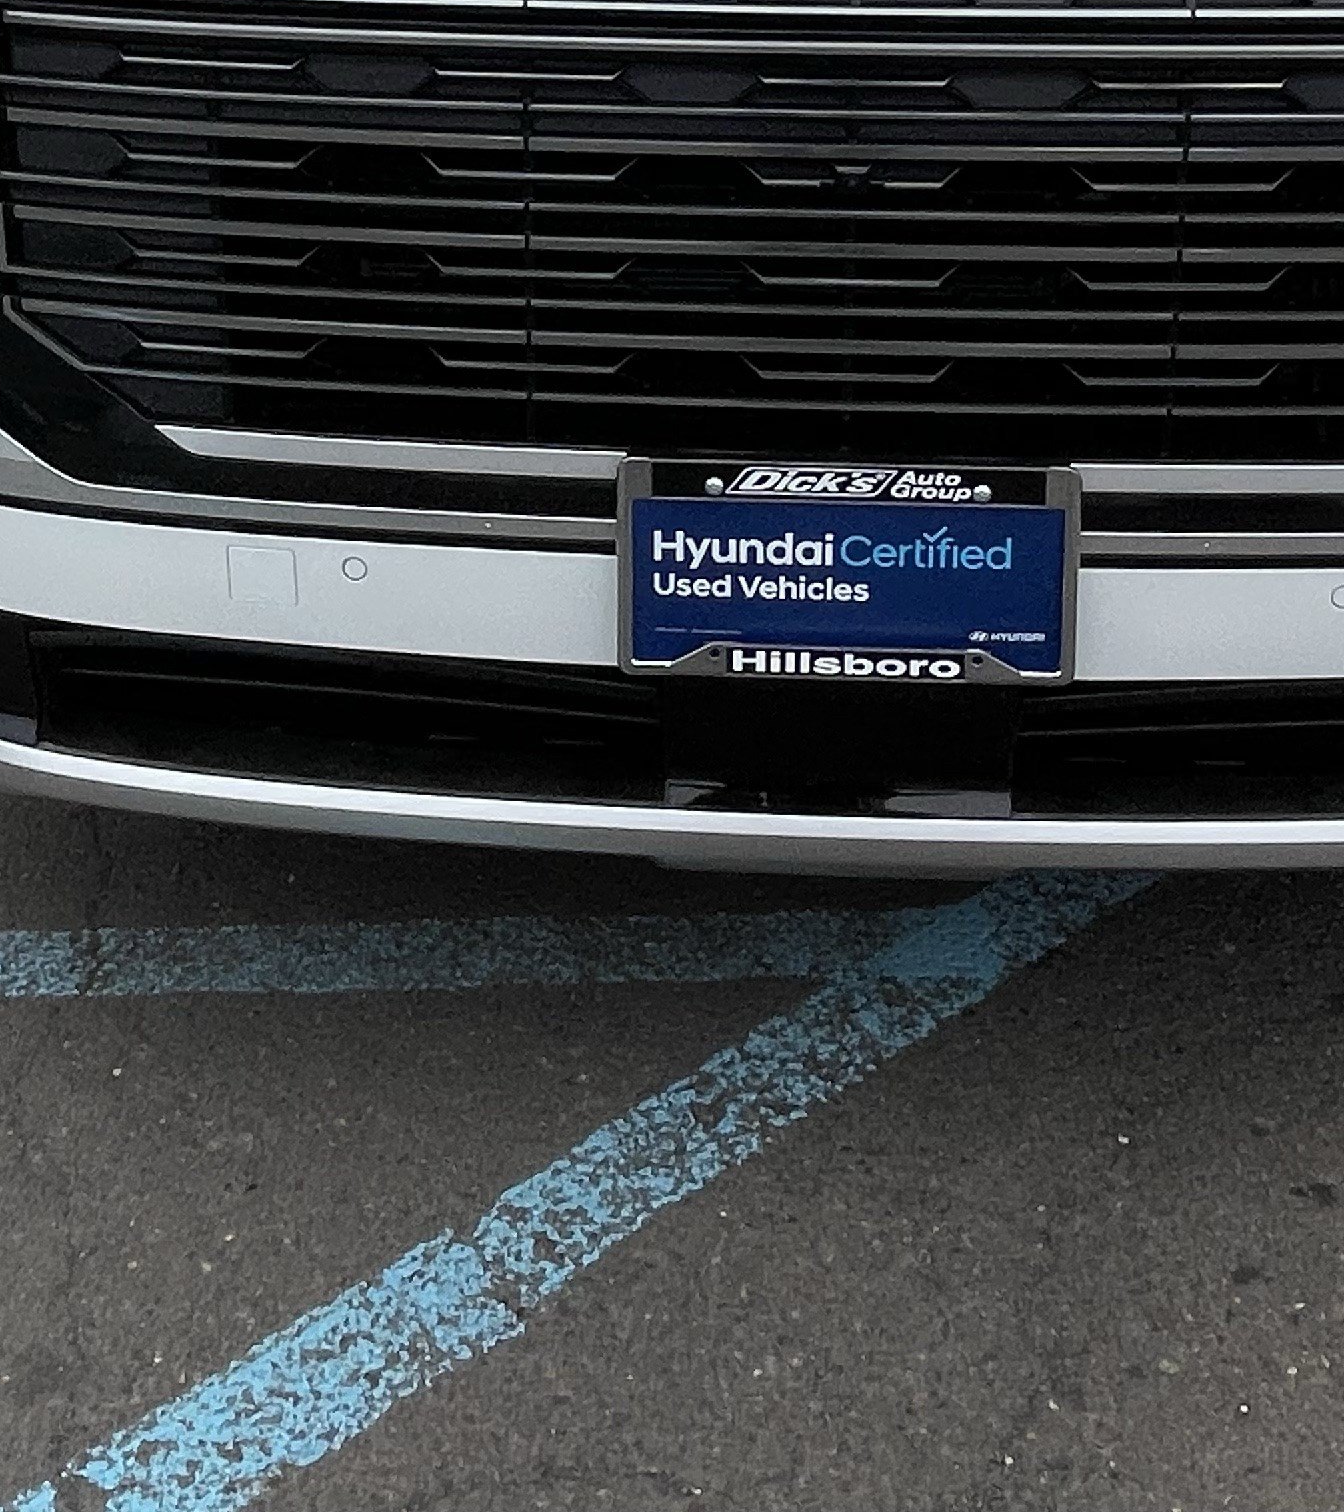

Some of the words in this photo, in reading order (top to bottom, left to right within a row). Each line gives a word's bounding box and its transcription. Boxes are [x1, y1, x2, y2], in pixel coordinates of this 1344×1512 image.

[896, 470, 961, 486] Auto
[890, 485, 972, 502] Group
[653, 529, 834, 569] Hyundai
[840, 529, 1012, 570] Certified
[653, 572, 732, 597] Used
[739, 575, 870, 602] Vehicles
[732, 649, 961, 678] Hillsboro
